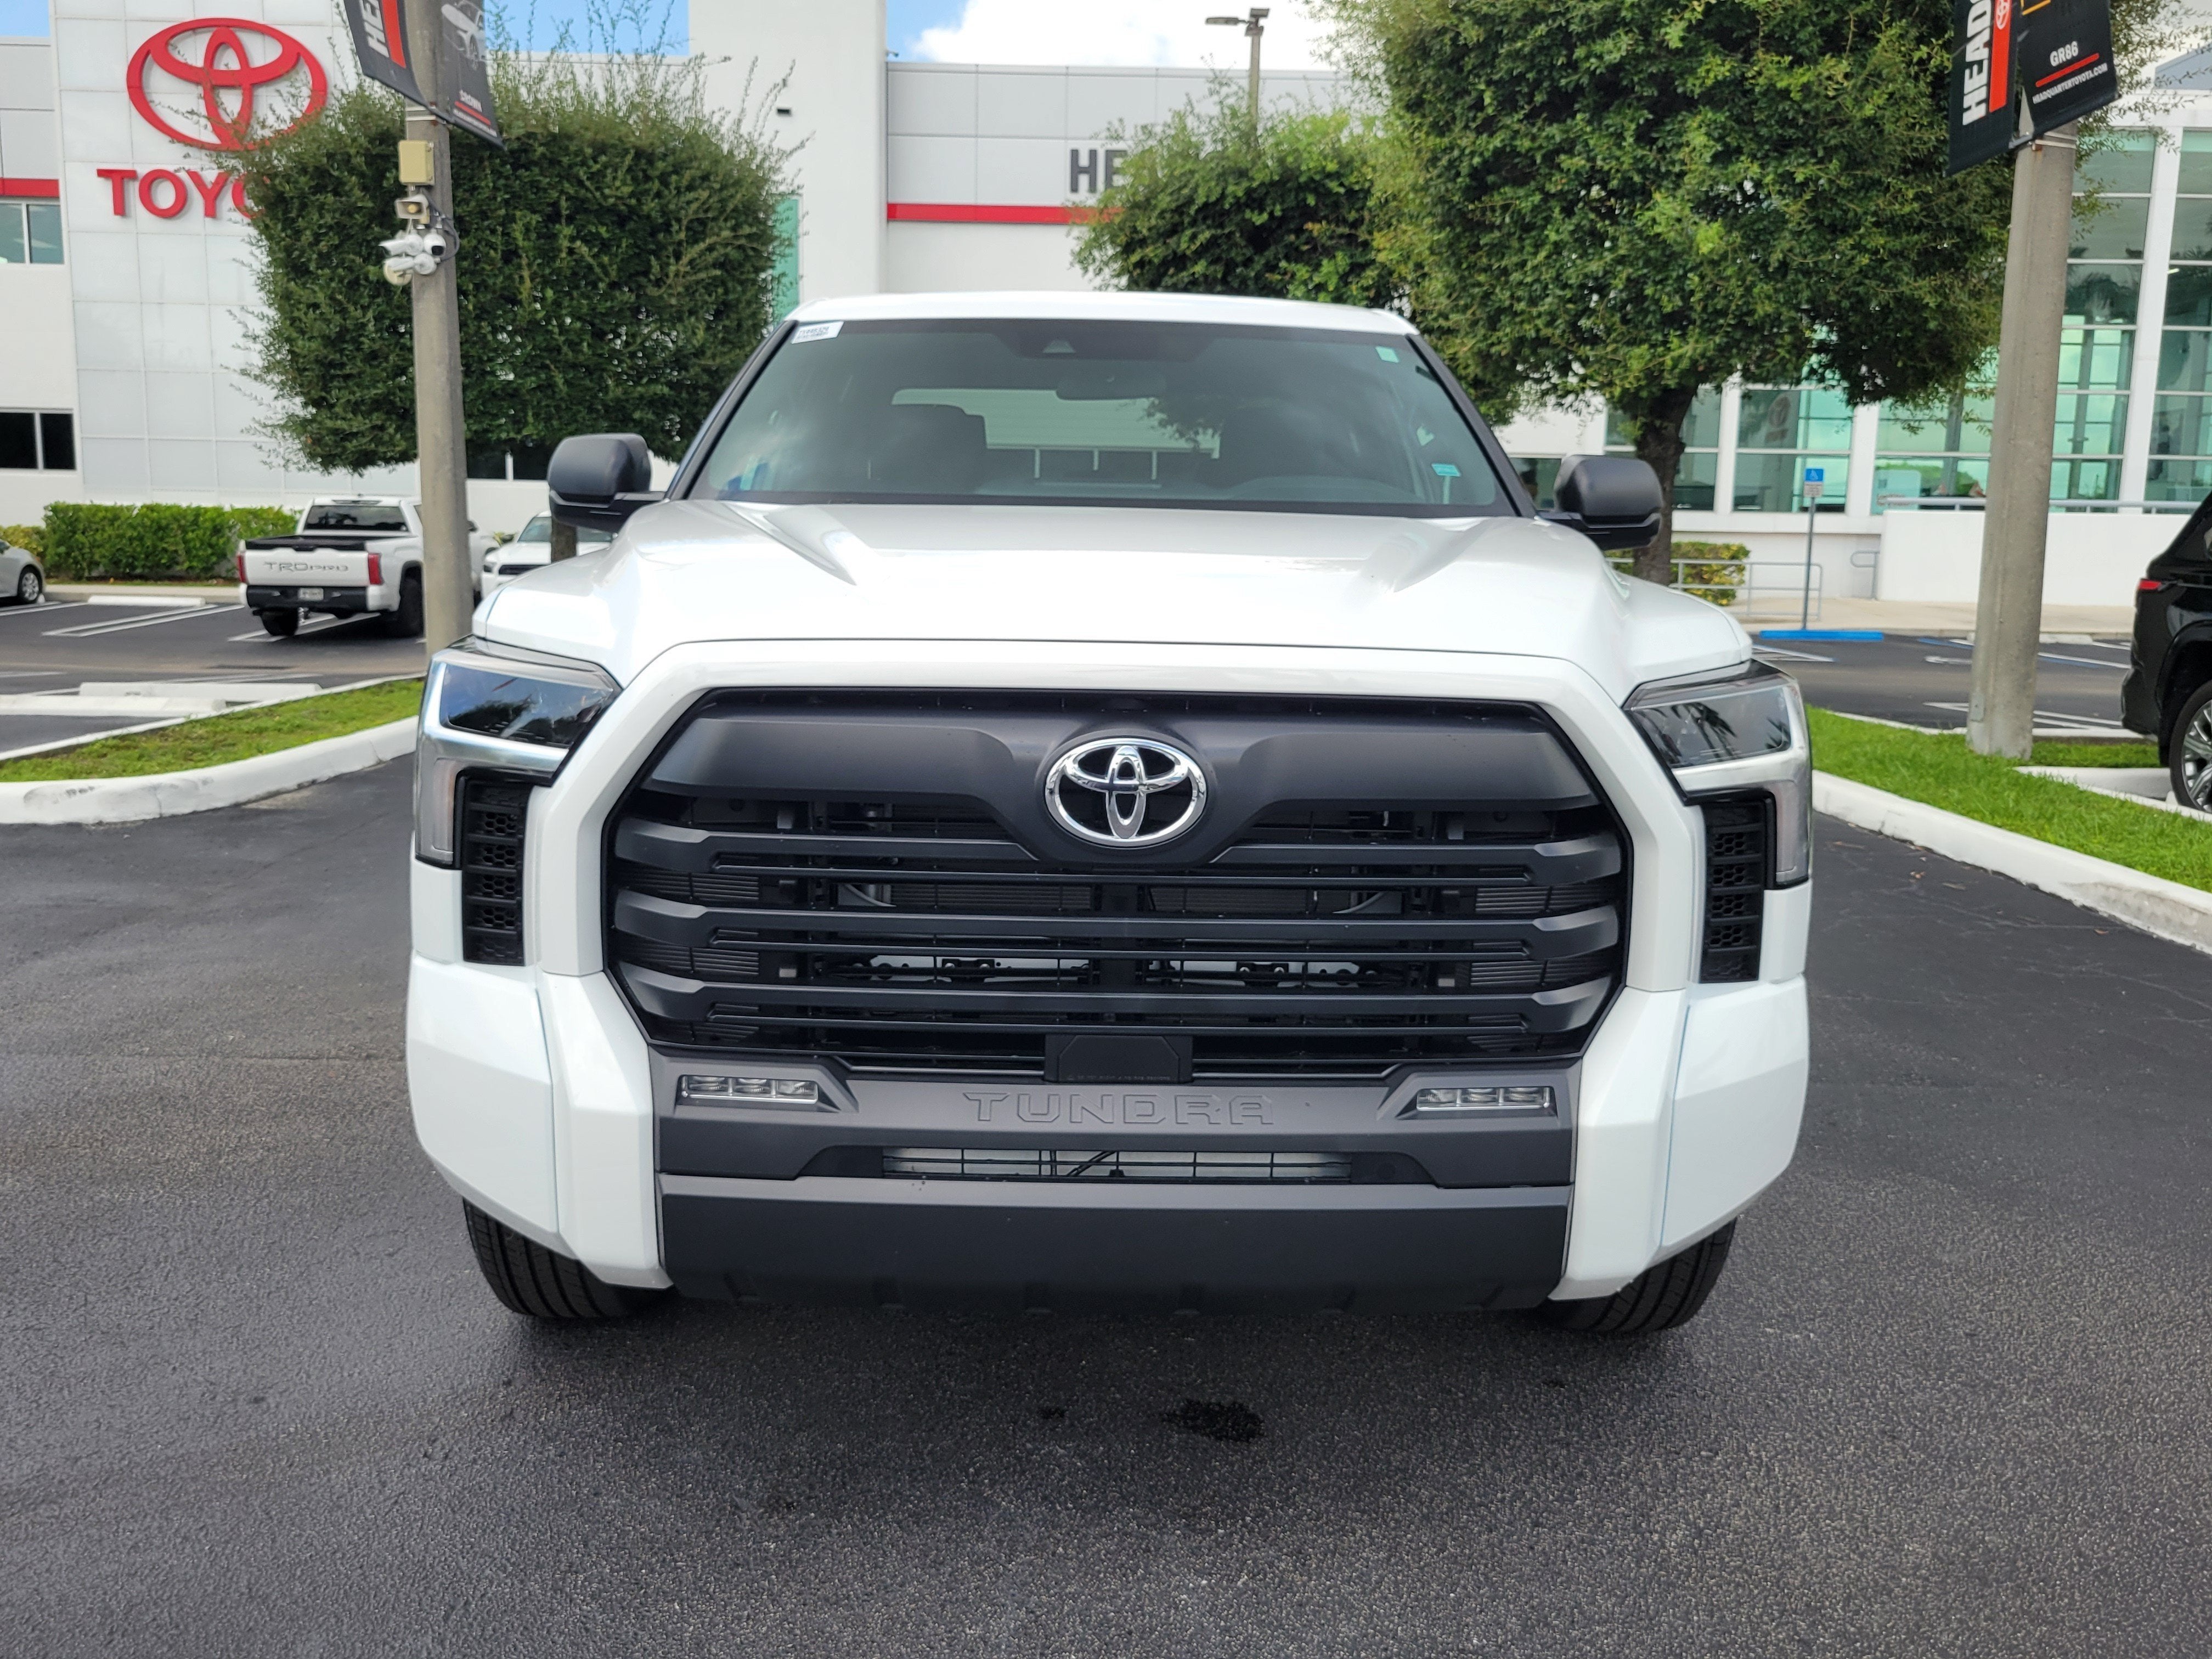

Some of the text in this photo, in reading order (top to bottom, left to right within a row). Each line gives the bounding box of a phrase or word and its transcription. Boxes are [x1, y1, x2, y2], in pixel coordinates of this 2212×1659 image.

[1962, 0, 1991, 125] HEAD
[2050, 41, 2079, 66] GR86
[2032, 63, 2108, 104] HEADQUARTERTOYOTA.COM
[263, 561, 308, 572] TRD
[962, 1092, 1274, 1125] TUNDRA
